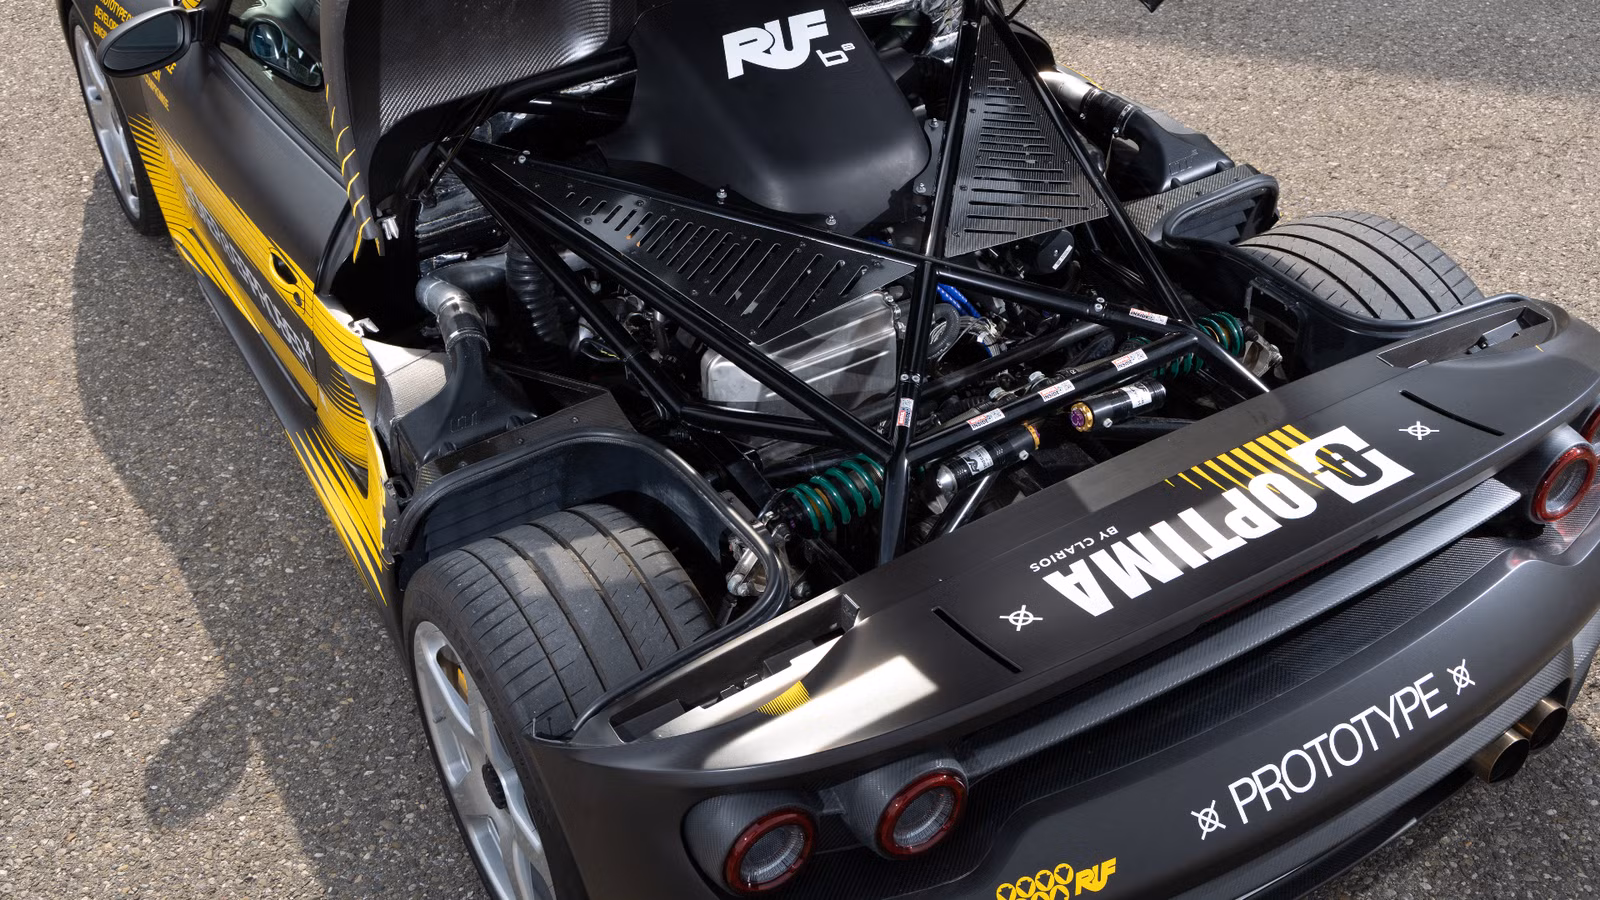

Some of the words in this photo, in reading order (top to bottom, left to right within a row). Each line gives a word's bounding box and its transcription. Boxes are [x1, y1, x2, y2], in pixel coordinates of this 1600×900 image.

[722, 9, 829, 80] RUF
[1029, 537, 1095, 573] CLARIOS
[1042, 472, 1318, 617] OPTIMA
[1099, 525, 1119, 541] BY
[1227, 672, 1448, 824] PROTOTYPE
[1075, 857, 1117, 896] RUF
